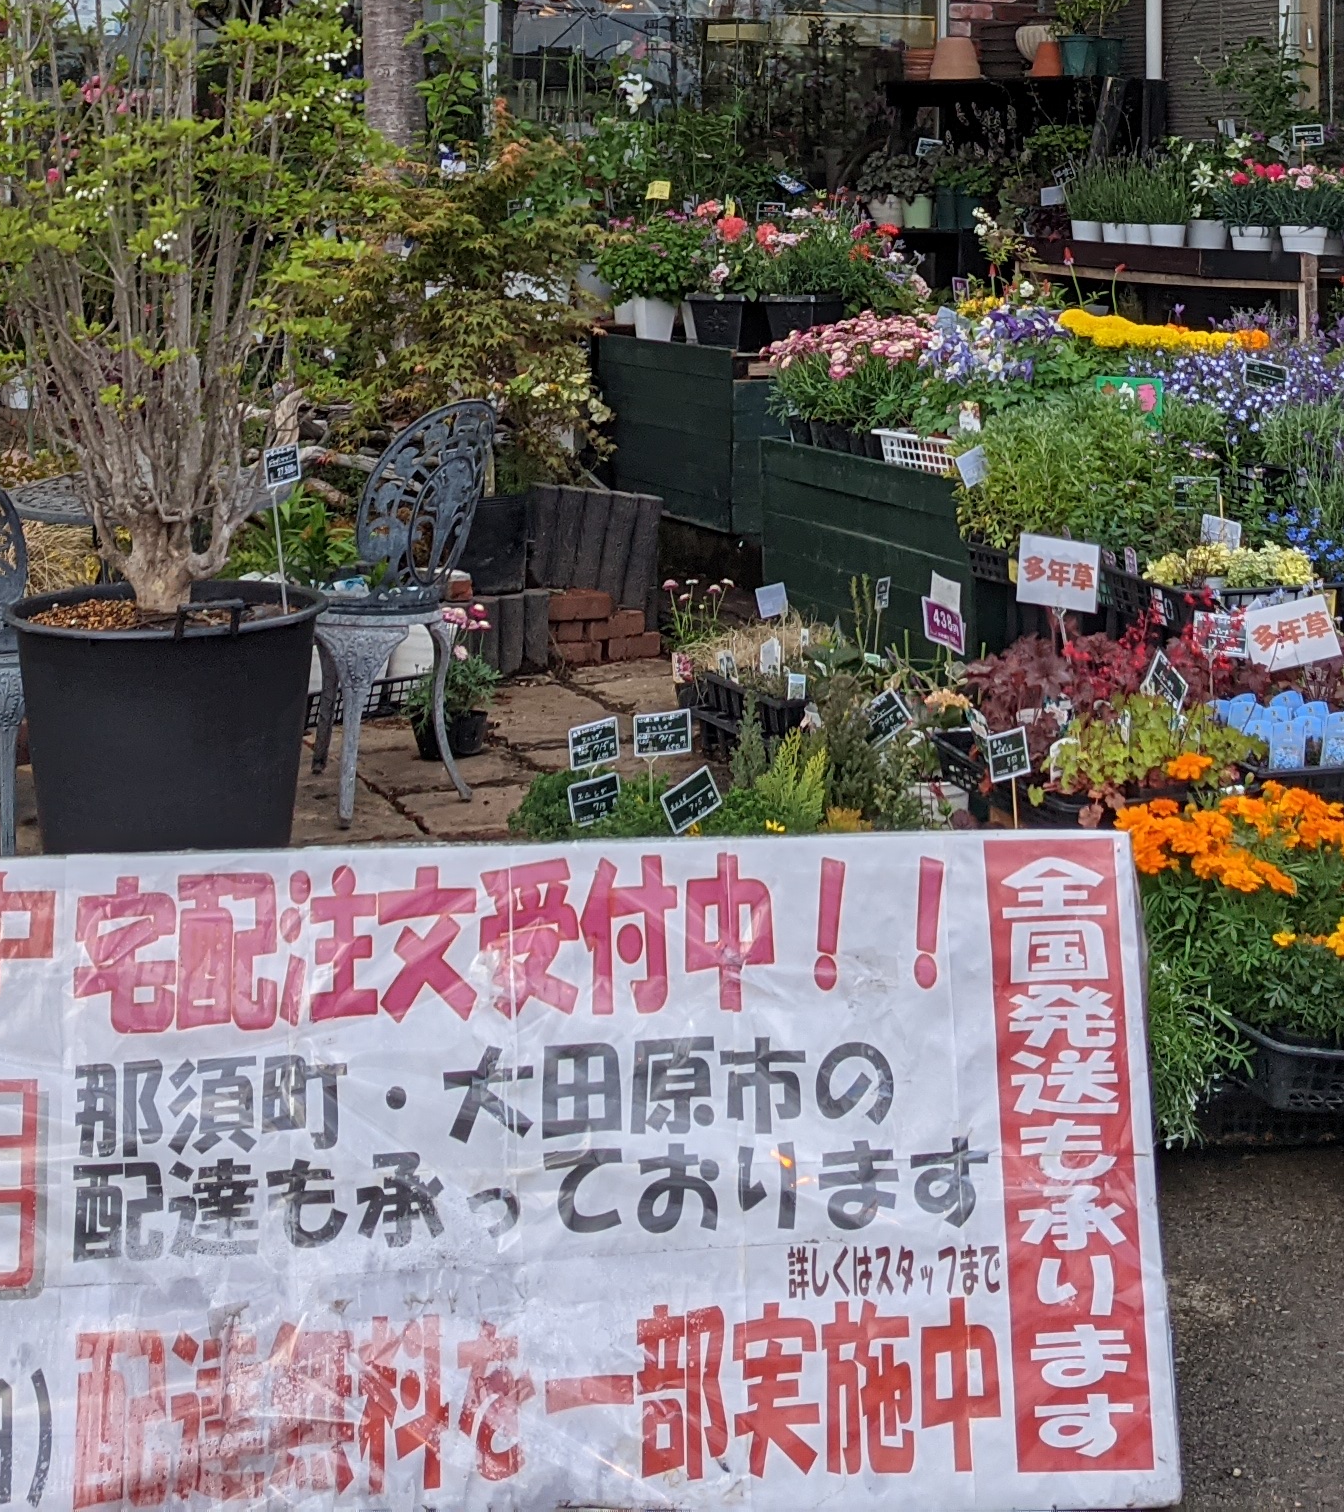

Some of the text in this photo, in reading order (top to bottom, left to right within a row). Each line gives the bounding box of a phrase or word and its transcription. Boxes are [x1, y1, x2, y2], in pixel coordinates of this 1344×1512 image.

[1022, 555, 1095, 591] 多年草
[1250, 610, 1334, 652] 多年草
[74, 1036, 893, 1158] 那須町・大田原市の
[72, 1136, 989, 1263] 配達も承っております
[1000, 855, 1135, 1460] 全国発送も承ります
[787, 1244, 1001, 1301] 詳しくはスタッフまで
